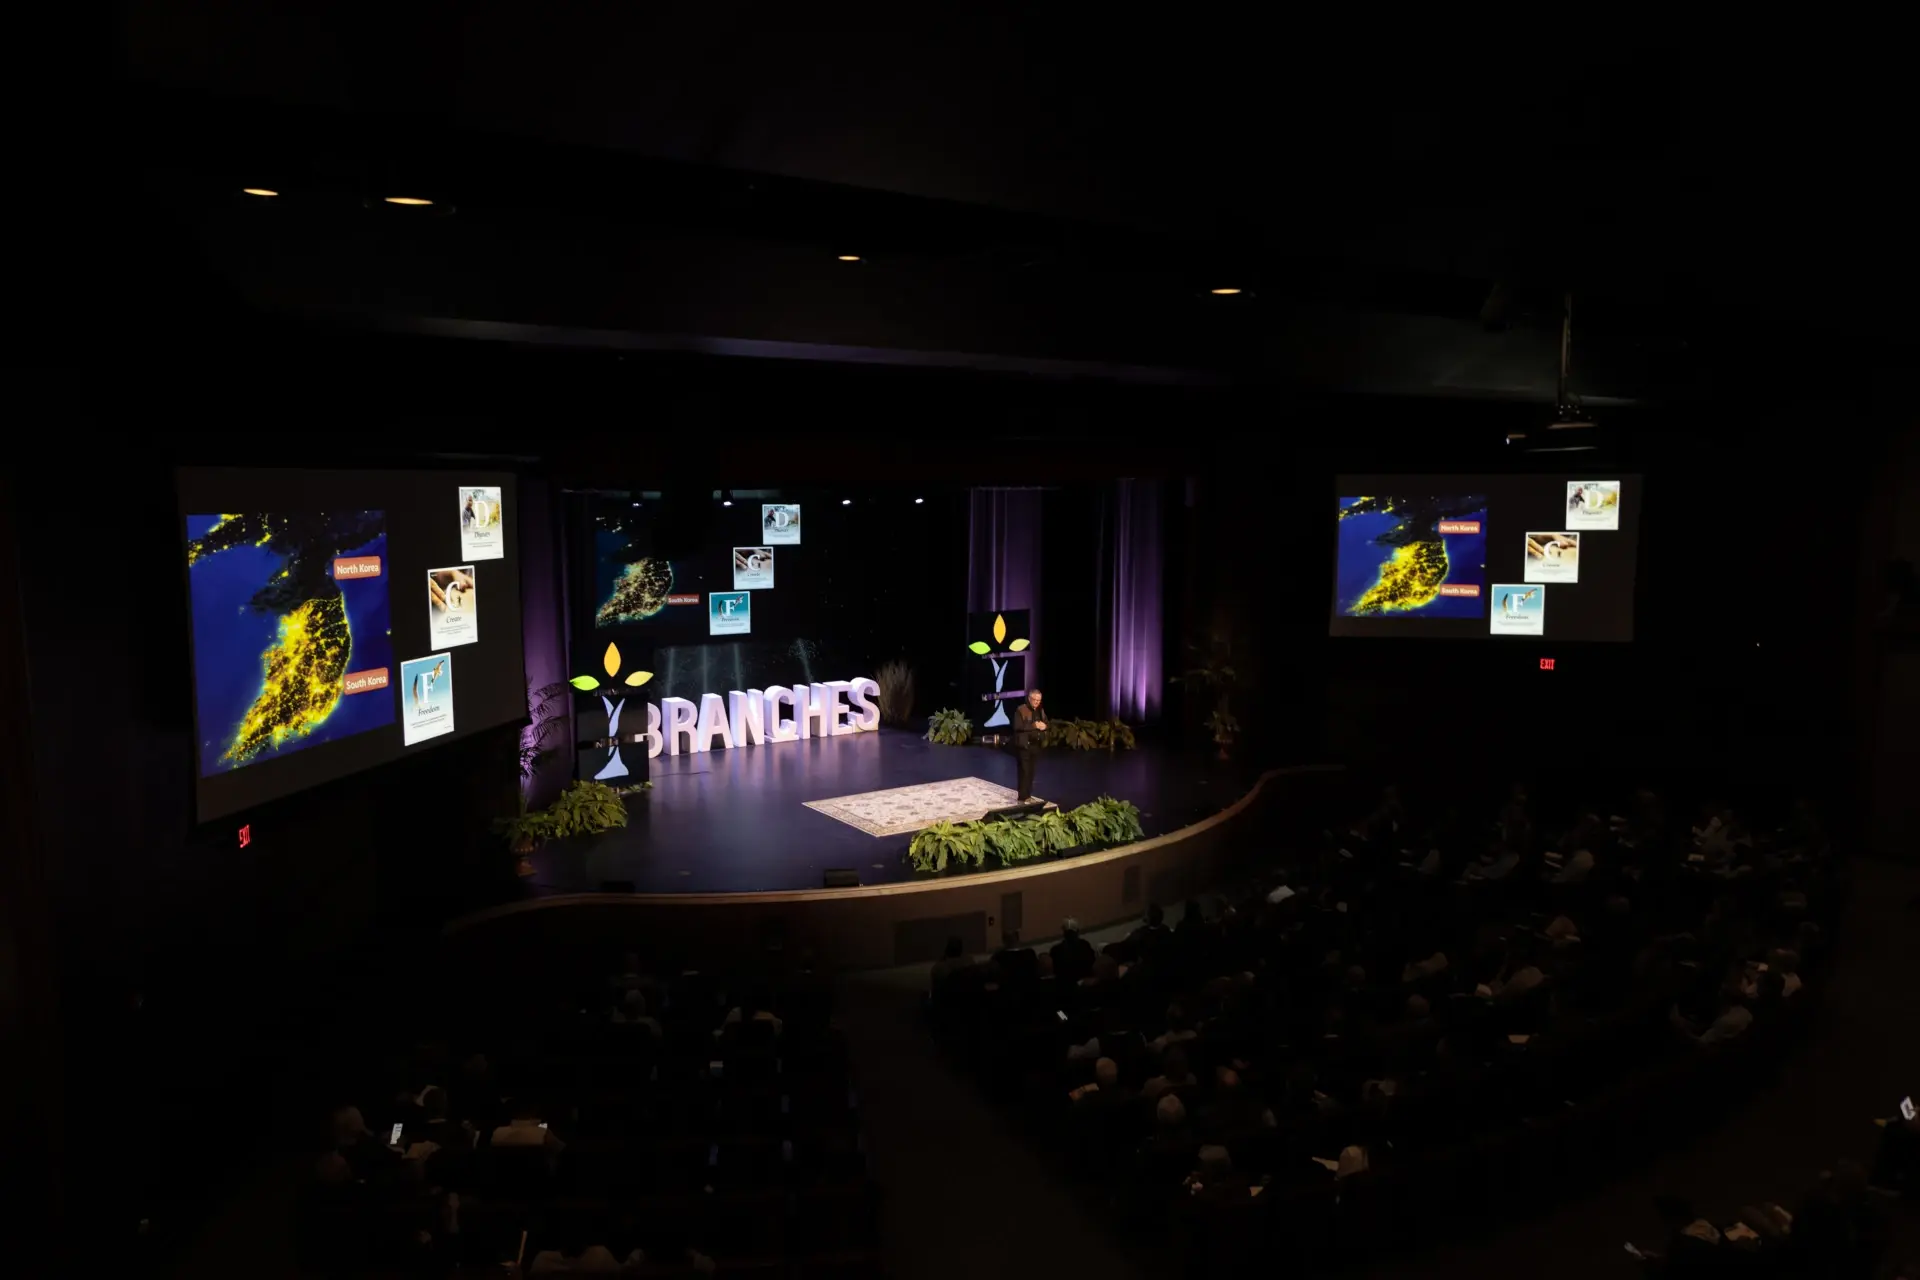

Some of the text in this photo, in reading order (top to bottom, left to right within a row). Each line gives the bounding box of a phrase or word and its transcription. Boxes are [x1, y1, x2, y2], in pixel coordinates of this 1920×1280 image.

[474, 500, 490, 528] D
[775, 511, 789, 528] D
[336, 563, 380, 575] North Korea
[723, 599, 736, 616] F
[1539, 658, 1555, 670] EXIT
[346, 675, 387, 690] South Korea
[420, 672, 434, 704] F
[646, 677, 881, 759] BRANCHES
